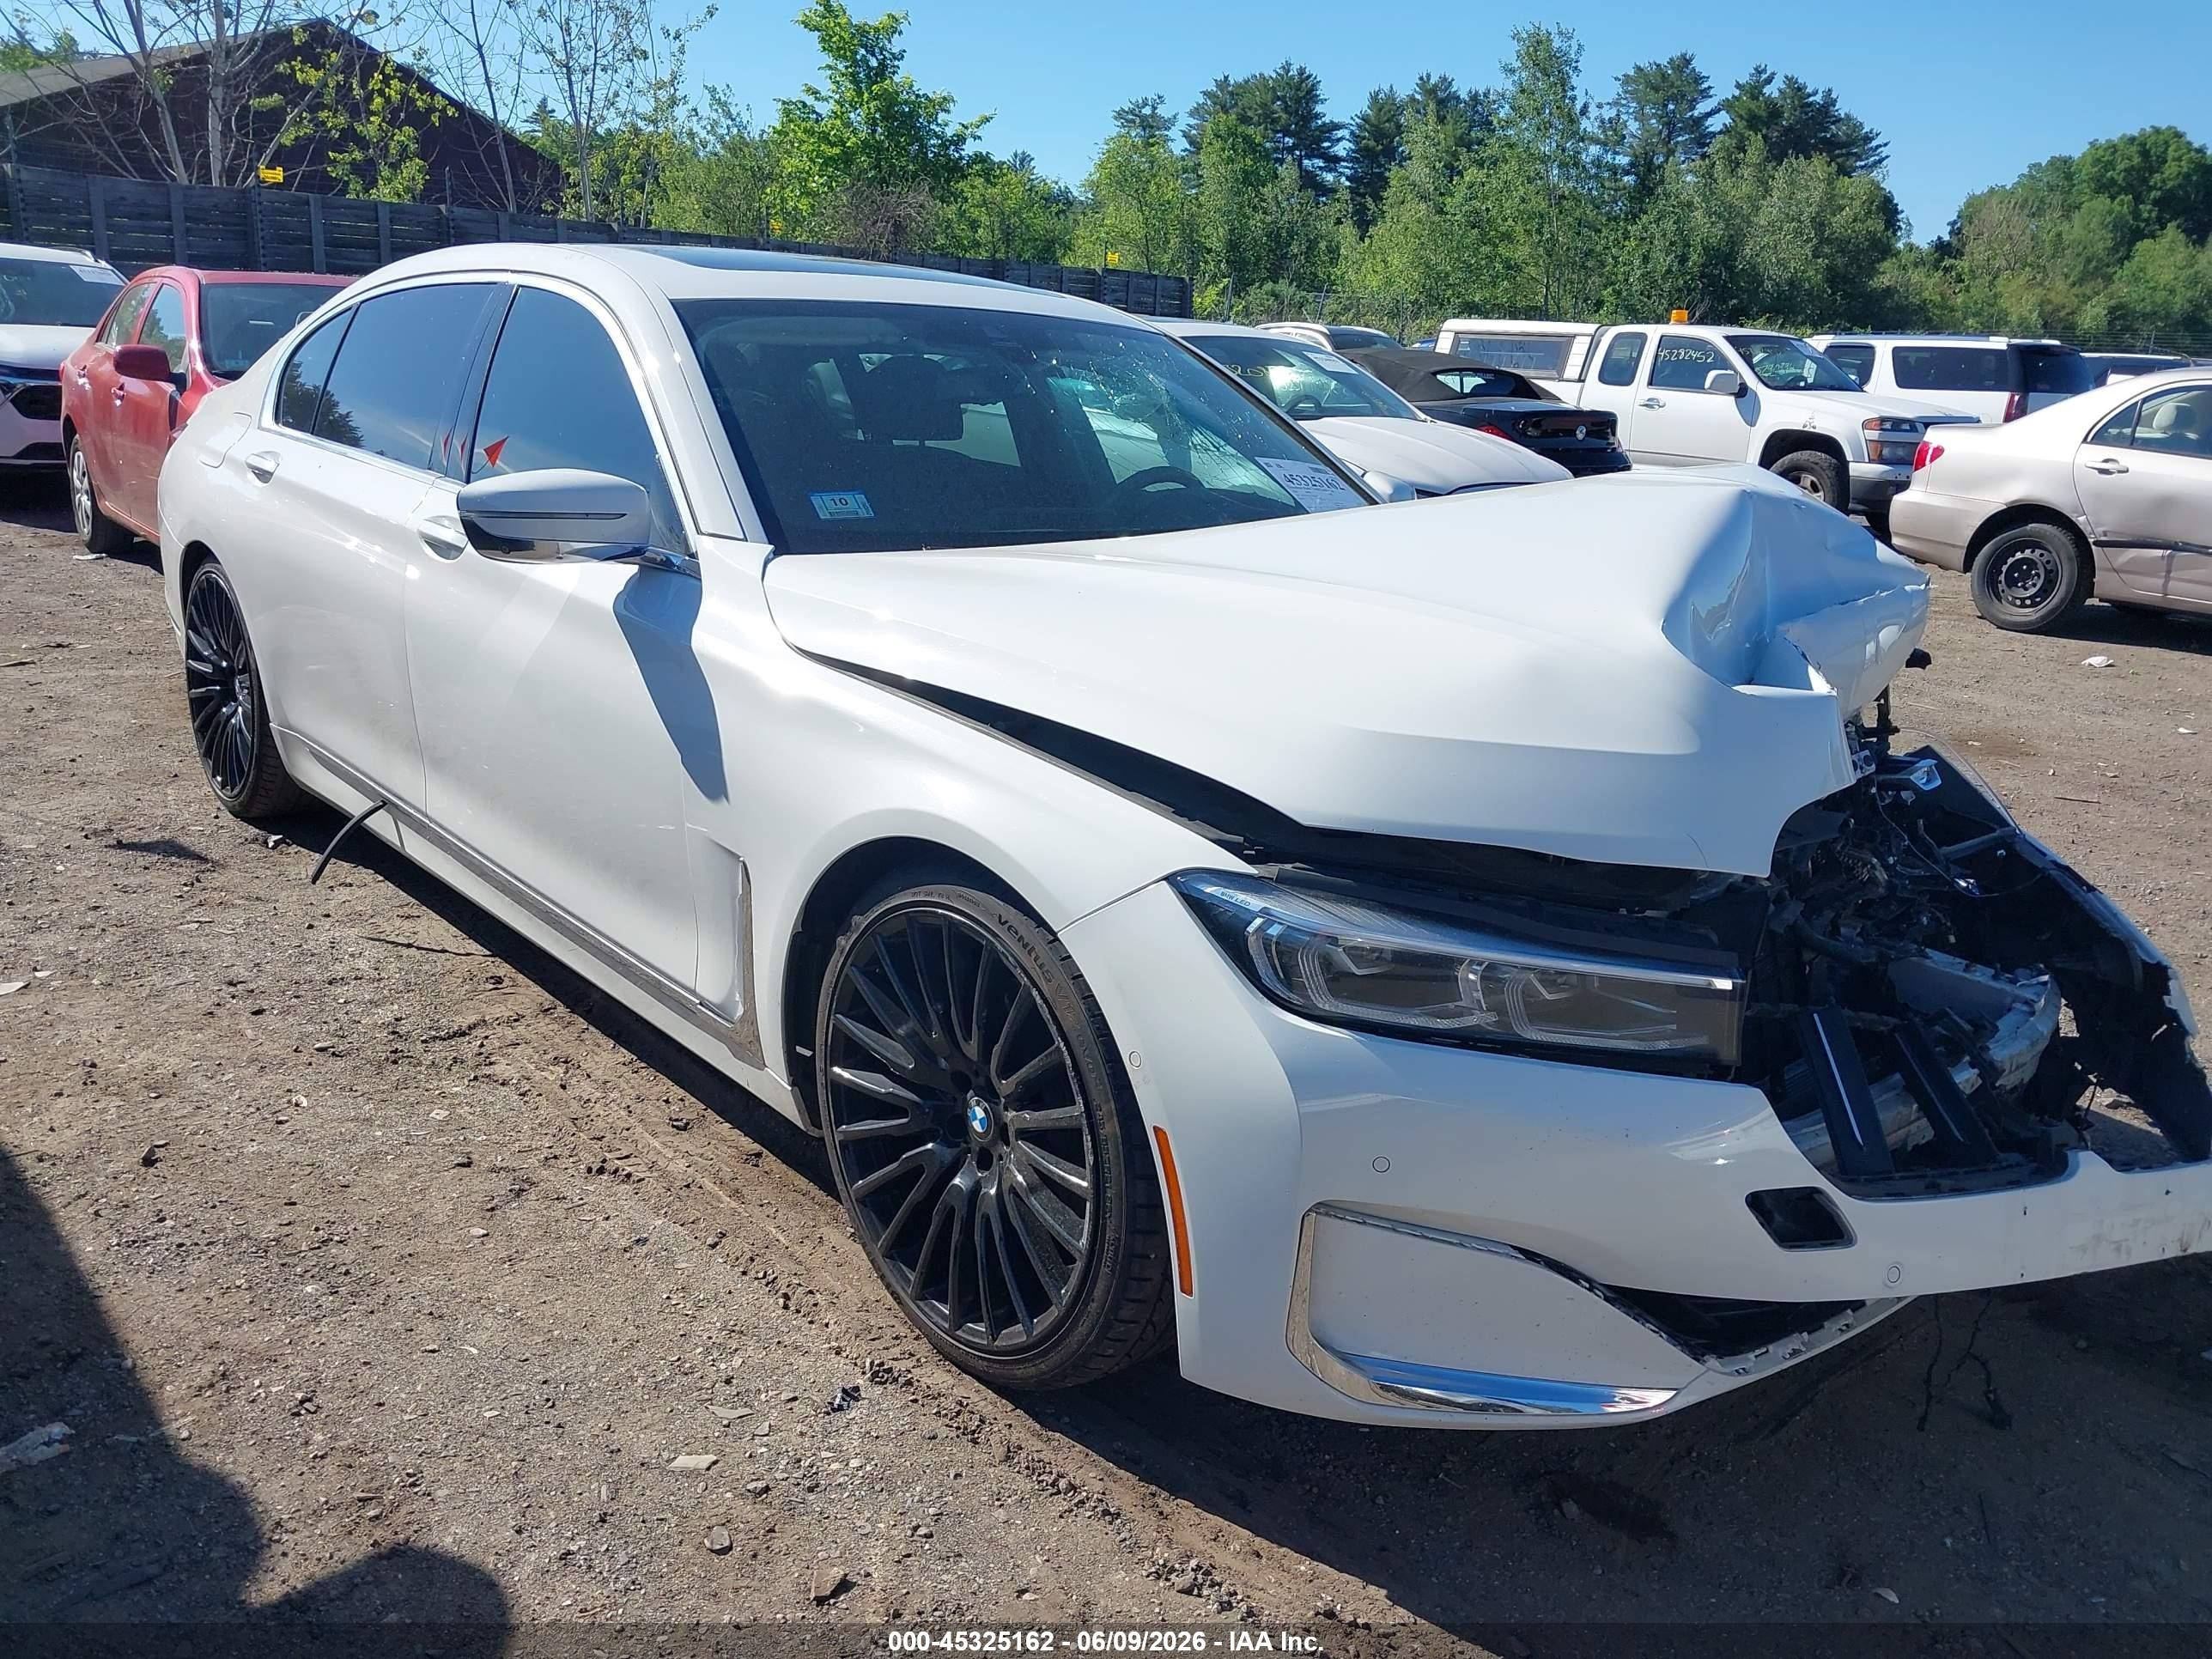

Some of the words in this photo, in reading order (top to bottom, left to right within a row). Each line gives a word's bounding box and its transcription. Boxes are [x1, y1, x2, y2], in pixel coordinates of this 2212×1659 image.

[1282, 473, 1346, 491] 45325162
[829, 497, 848, 507] 10
[1235, 897, 1251, 907] LED
